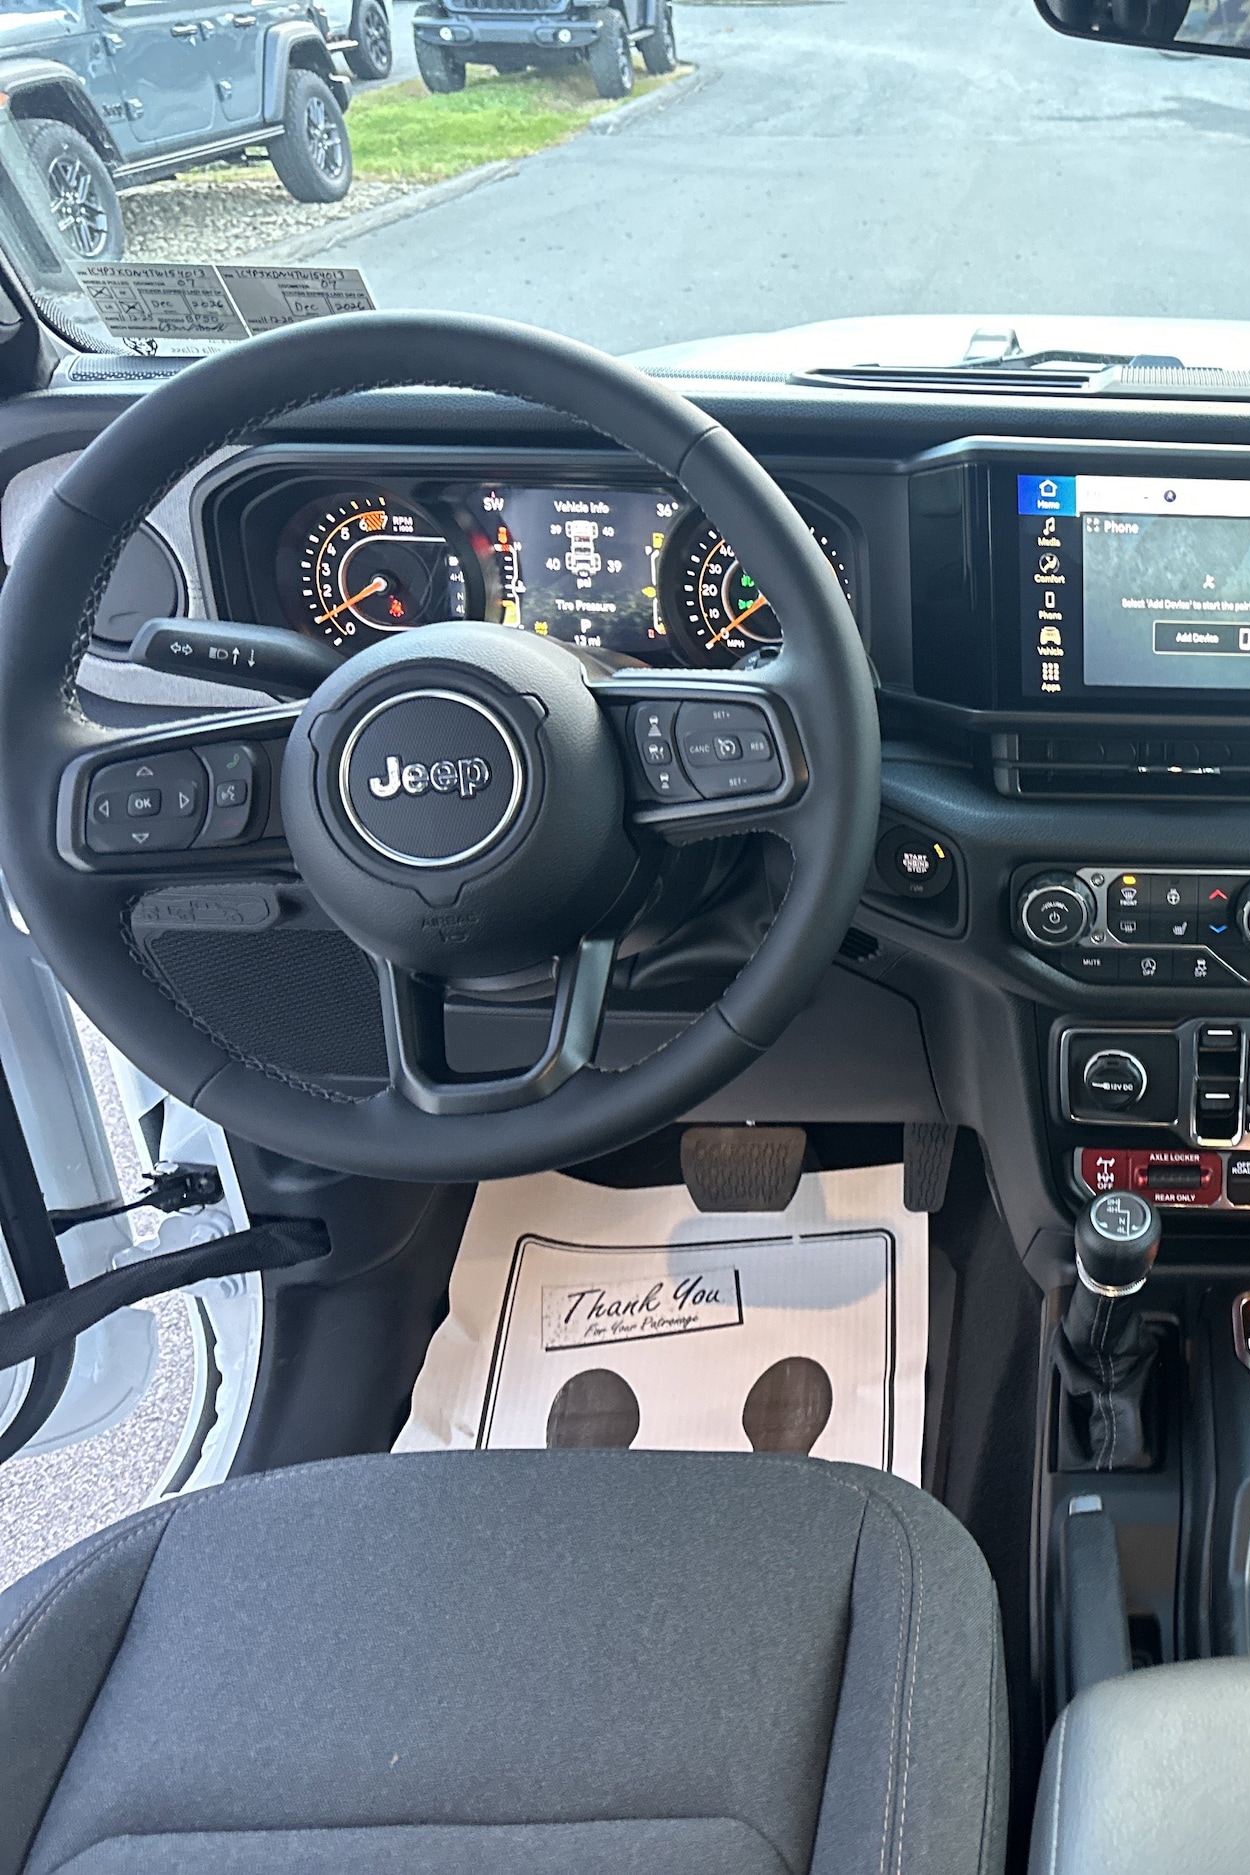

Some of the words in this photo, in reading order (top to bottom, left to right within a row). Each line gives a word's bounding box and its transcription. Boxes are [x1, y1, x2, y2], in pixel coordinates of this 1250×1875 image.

[295, 303, 319, 312] Dec
[483, 498, 505, 512] SW
[553, 501, 589, 514] Vehicle
[590, 501, 610, 514] Info
[1037, 500, 1061, 511] Home
[392, 516, 414, 527] RPM
[1104, 521, 1140, 535] Phone
[340, 527, 351, 541] 5
[1038, 537, 1061, 548] Media
[327, 543, 337, 557] 4
[322, 563, 331, 576] 3
[546, 558, 562, 571] 40
[607, 560, 623, 574] 39
[709, 564, 723, 575] 30
[1034, 573, 1066, 585] Comfort
[323, 580, 333, 598] 2
[702, 584, 718, 597] 20
[555, 600, 575, 612] Tire
[575, 600, 617, 613] Pressure
[1121, 598, 1145, 610] Select
[1193, 601, 1202, 612] to
[1202, 601, 1221, 612] start
[1221, 601, 1235, 612] the
[709, 609, 720, 620] 10
[1038, 610, 1063, 621] Phone
[346, 622, 357, 636] 0
[580, 619, 592, 633] P
[727, 639, 746, 649] MPH
[1176, 633, 1193, 644] Add
[1193, 633, 1220, 645] Device
[1037, 646, 1065, 657] Vehicle
[1041, 682, 1062, 693] Apps
[369, 755, 492, 800] Jeep
[134, 798, 152, 811] OK
[1083, 959, 1102, 967] MUTE
[1150, 1154, 1169, 1162] AXLE
[1170, 1154, 1200, 1163] LOCKER
[1097, 1183, 1114, 1191] OFF
[1175, 1194, 1196, 1203] ONLY
[564, 1282, 664, 1325] Thank
[673, 1276, 721, 1311] You
[584, 1325, 607, 1338] For
[611, 1320, 637, 1336] Your
[640, 1314, 700, 1332] Patronage
